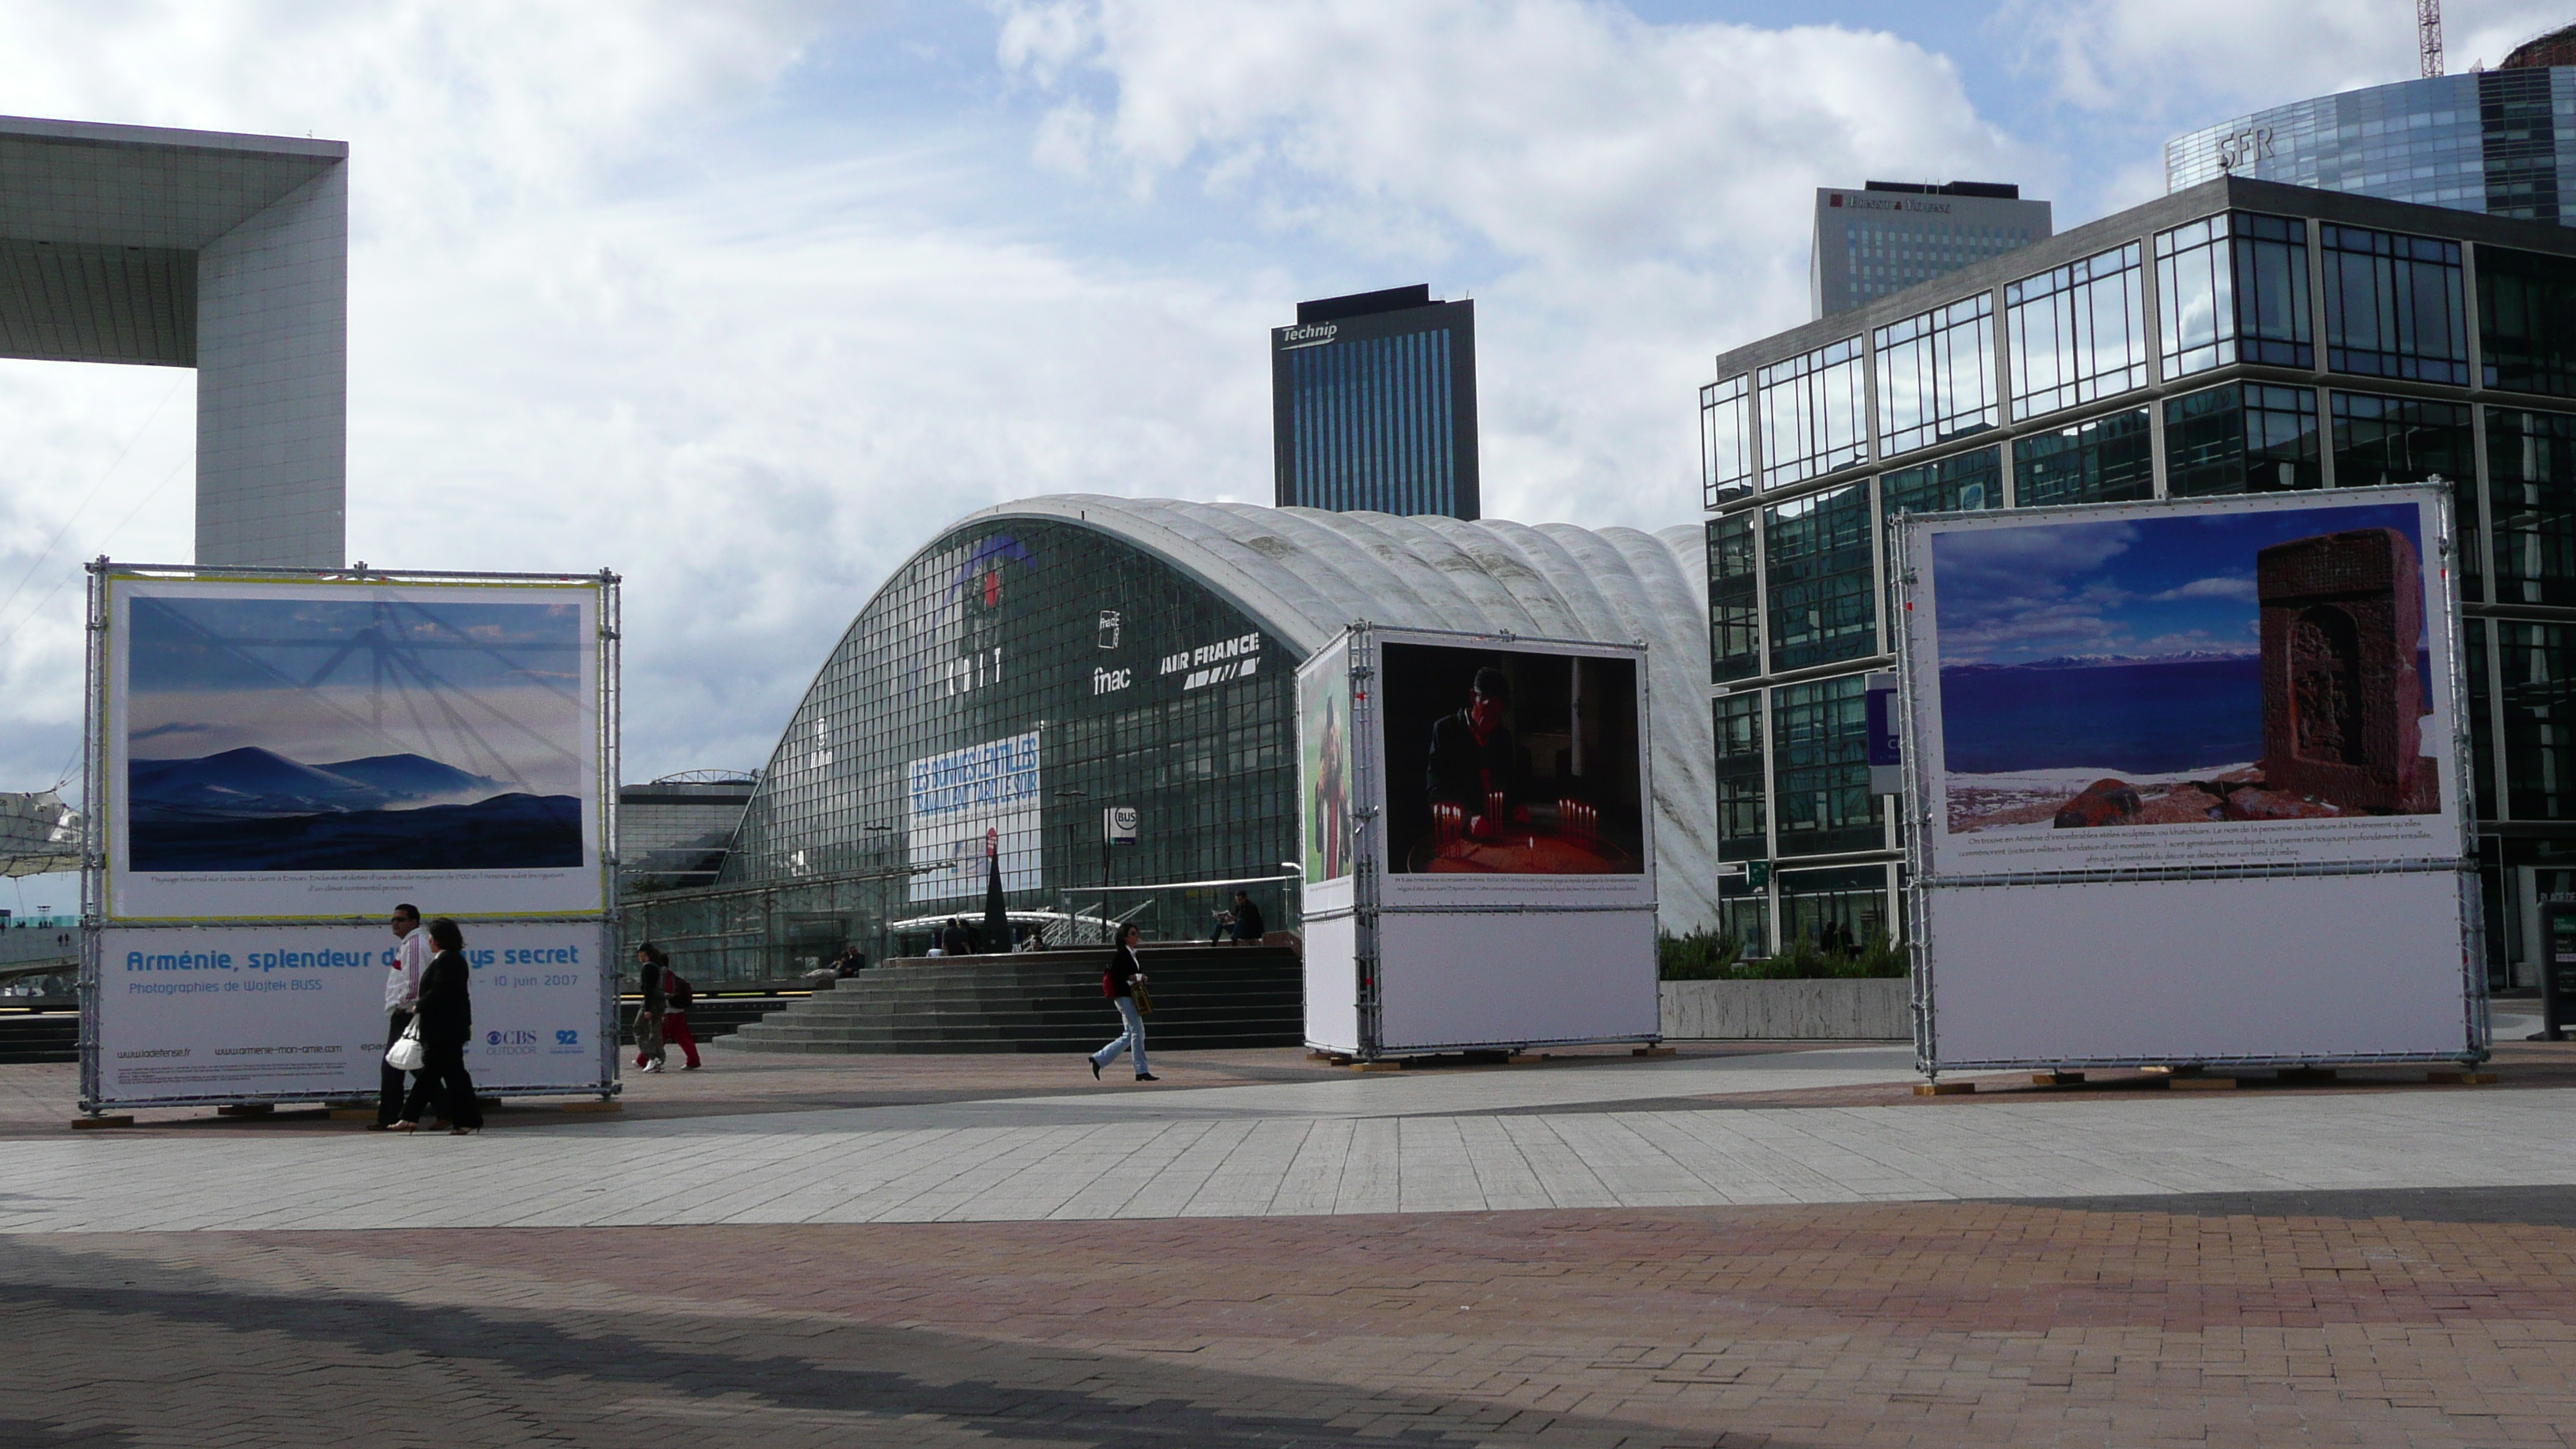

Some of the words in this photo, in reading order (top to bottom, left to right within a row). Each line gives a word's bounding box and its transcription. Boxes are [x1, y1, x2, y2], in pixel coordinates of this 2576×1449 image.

[2216, 124, 2275, 169] SFR
[1282, 321, 1338, 341] Technip
[1160, 652, 1189, 675] AIR
[1194, 632, 1259, 666] FRANCE
[1094, 666, 1131, 695] fnac
[912, 763, 929, 793] LES
[1118, 812, 1136, 821] BUS
[2280, 837, 2300, 846] pierre
[127, 950, 238, 972] Arménie,
[248, 948, 372, 972] splendeur
[505, 945, 578, 965] secret
[129, 981, 219, 995] Photographies
[224, 981, 238, 992] de
[244, 979, 286, 992] Wojtek
[291, 979, 322, 991] BUSS
[495, 976, 507, 987] 10
[513, 976, 537, 988] juin
[544, 975, 578, 986] 2007
[504, 1030, 536, 1045] CBS
[555, 1029, 578, 1045] 92
[486, 1046, 536, 1055] OUTDOOR
